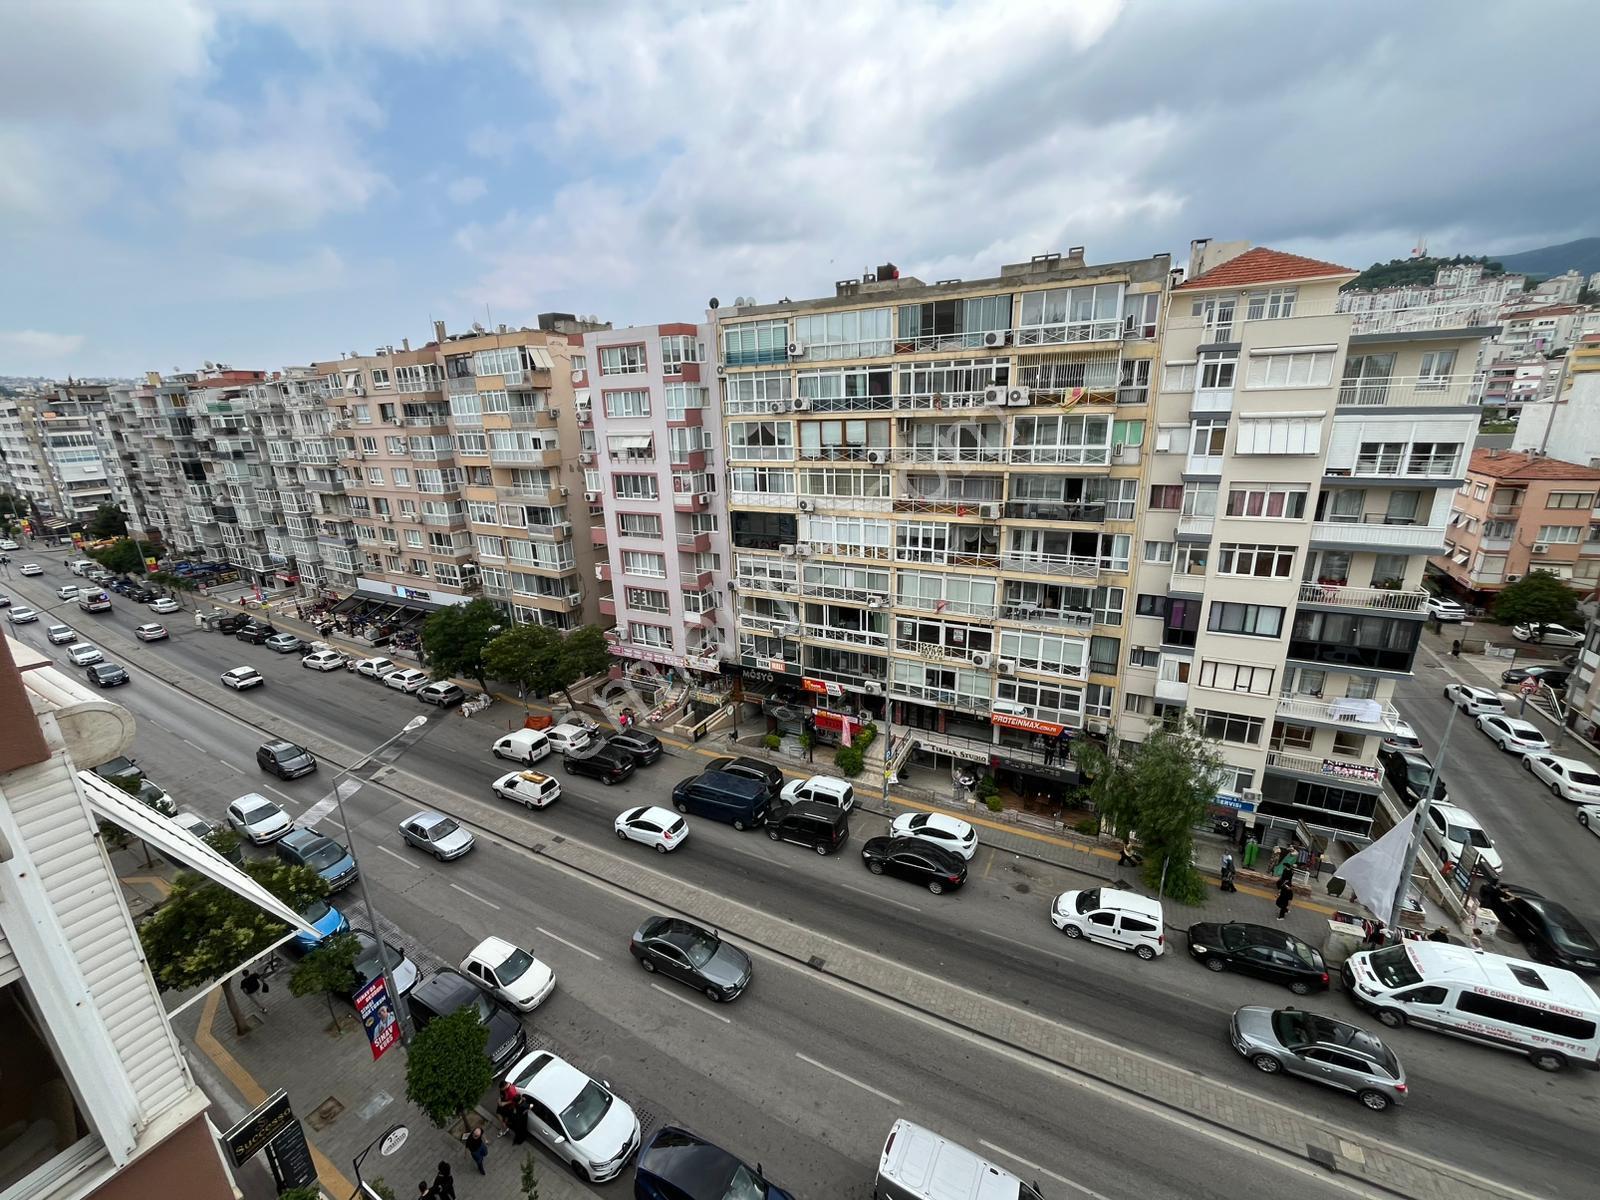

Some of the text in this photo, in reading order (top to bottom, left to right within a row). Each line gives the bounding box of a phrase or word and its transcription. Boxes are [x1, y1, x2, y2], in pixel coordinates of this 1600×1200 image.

[960, 751, 986, 762] STUDIO
[1474, 986, 1488, 996] EGE
[374, 1025, 393, 1047] SINAV
[235, 1106, 291, 1157] Successo
